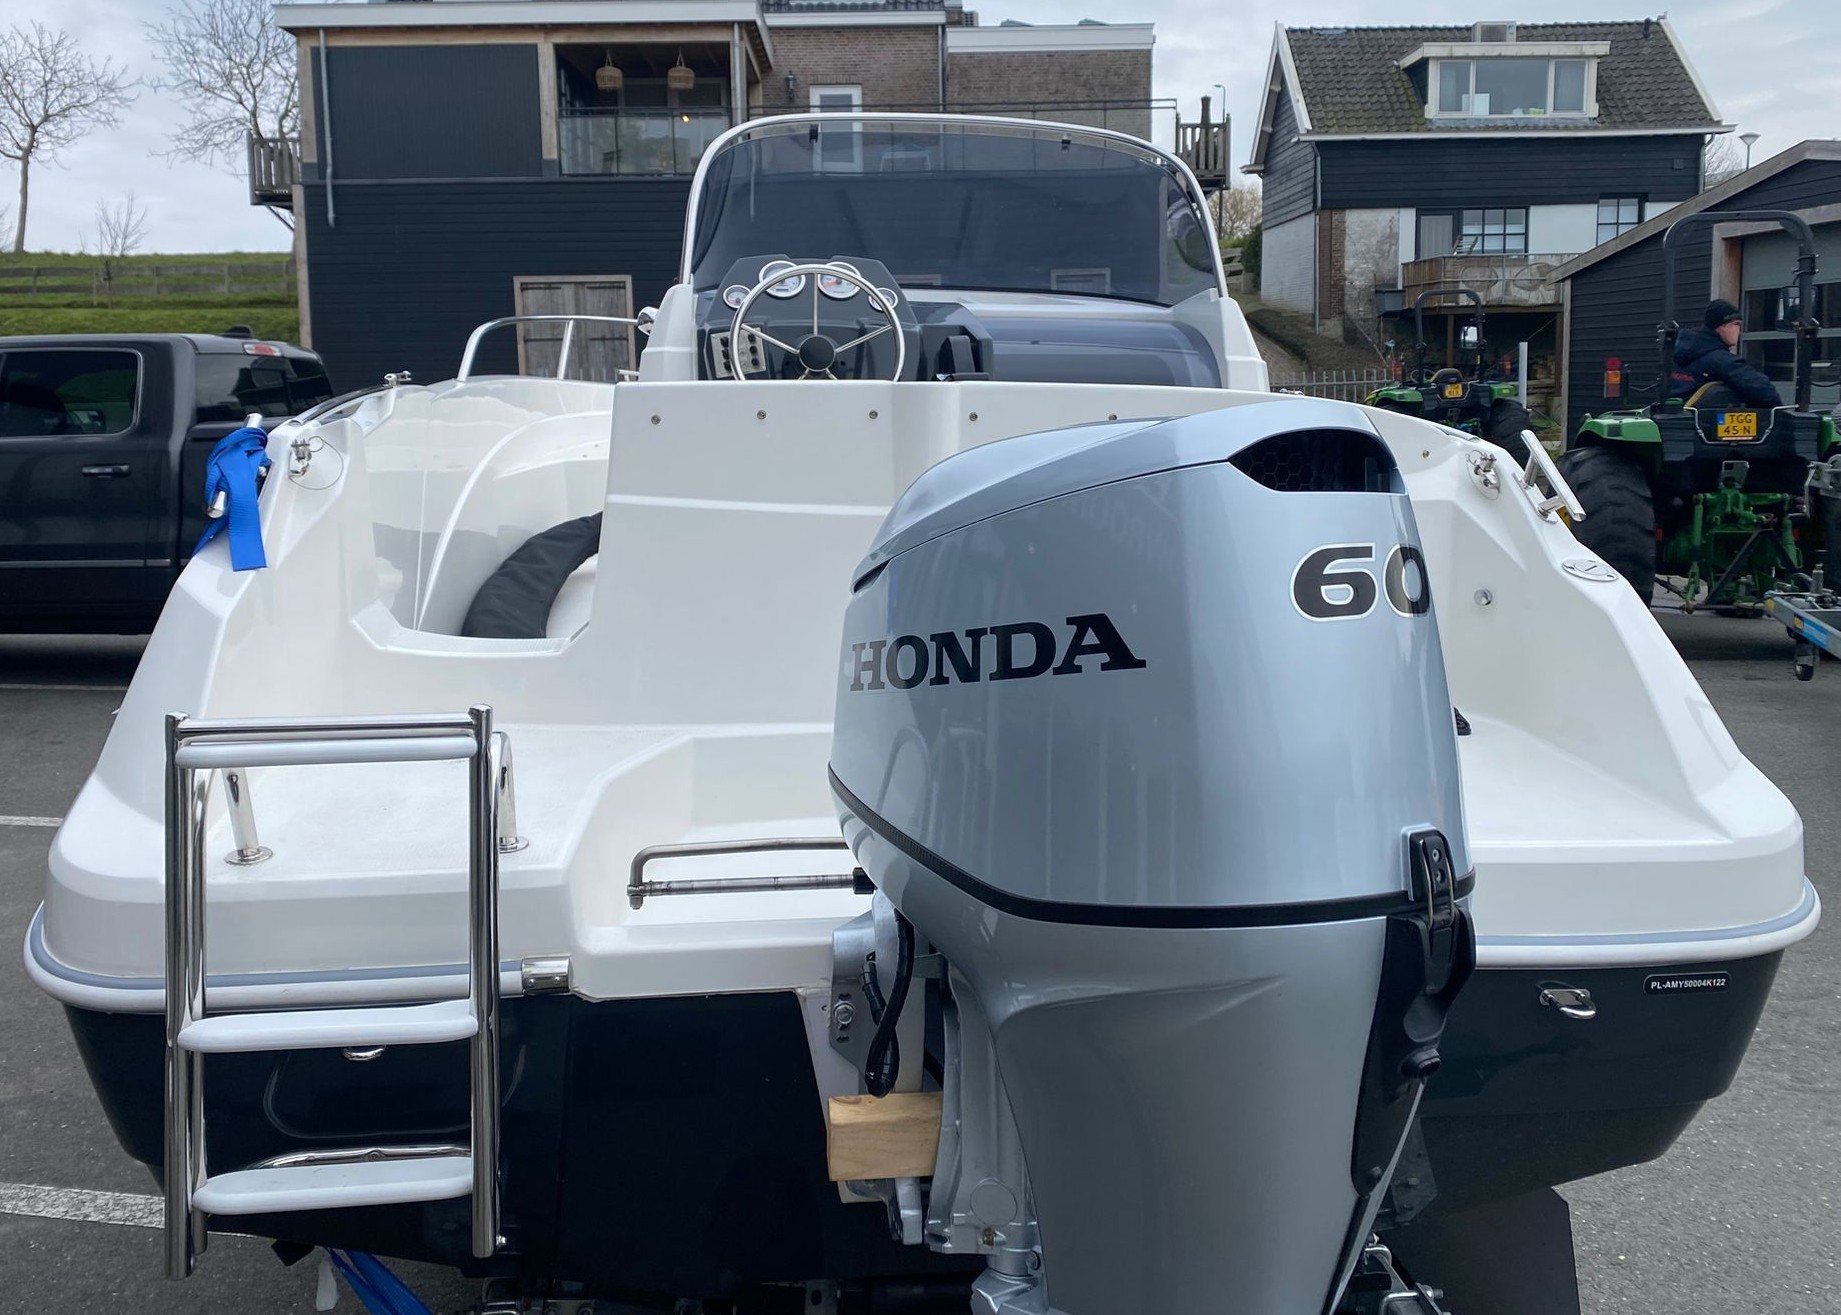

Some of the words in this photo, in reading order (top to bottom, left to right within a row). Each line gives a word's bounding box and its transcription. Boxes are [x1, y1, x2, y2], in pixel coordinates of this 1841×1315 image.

[1723, 425, 1751, 435] 45-N
[1729, 414, 1752, 424] TGG
[1290, 543, 1430, 622] 60
[850, 613, 1146, 691] HONDA
